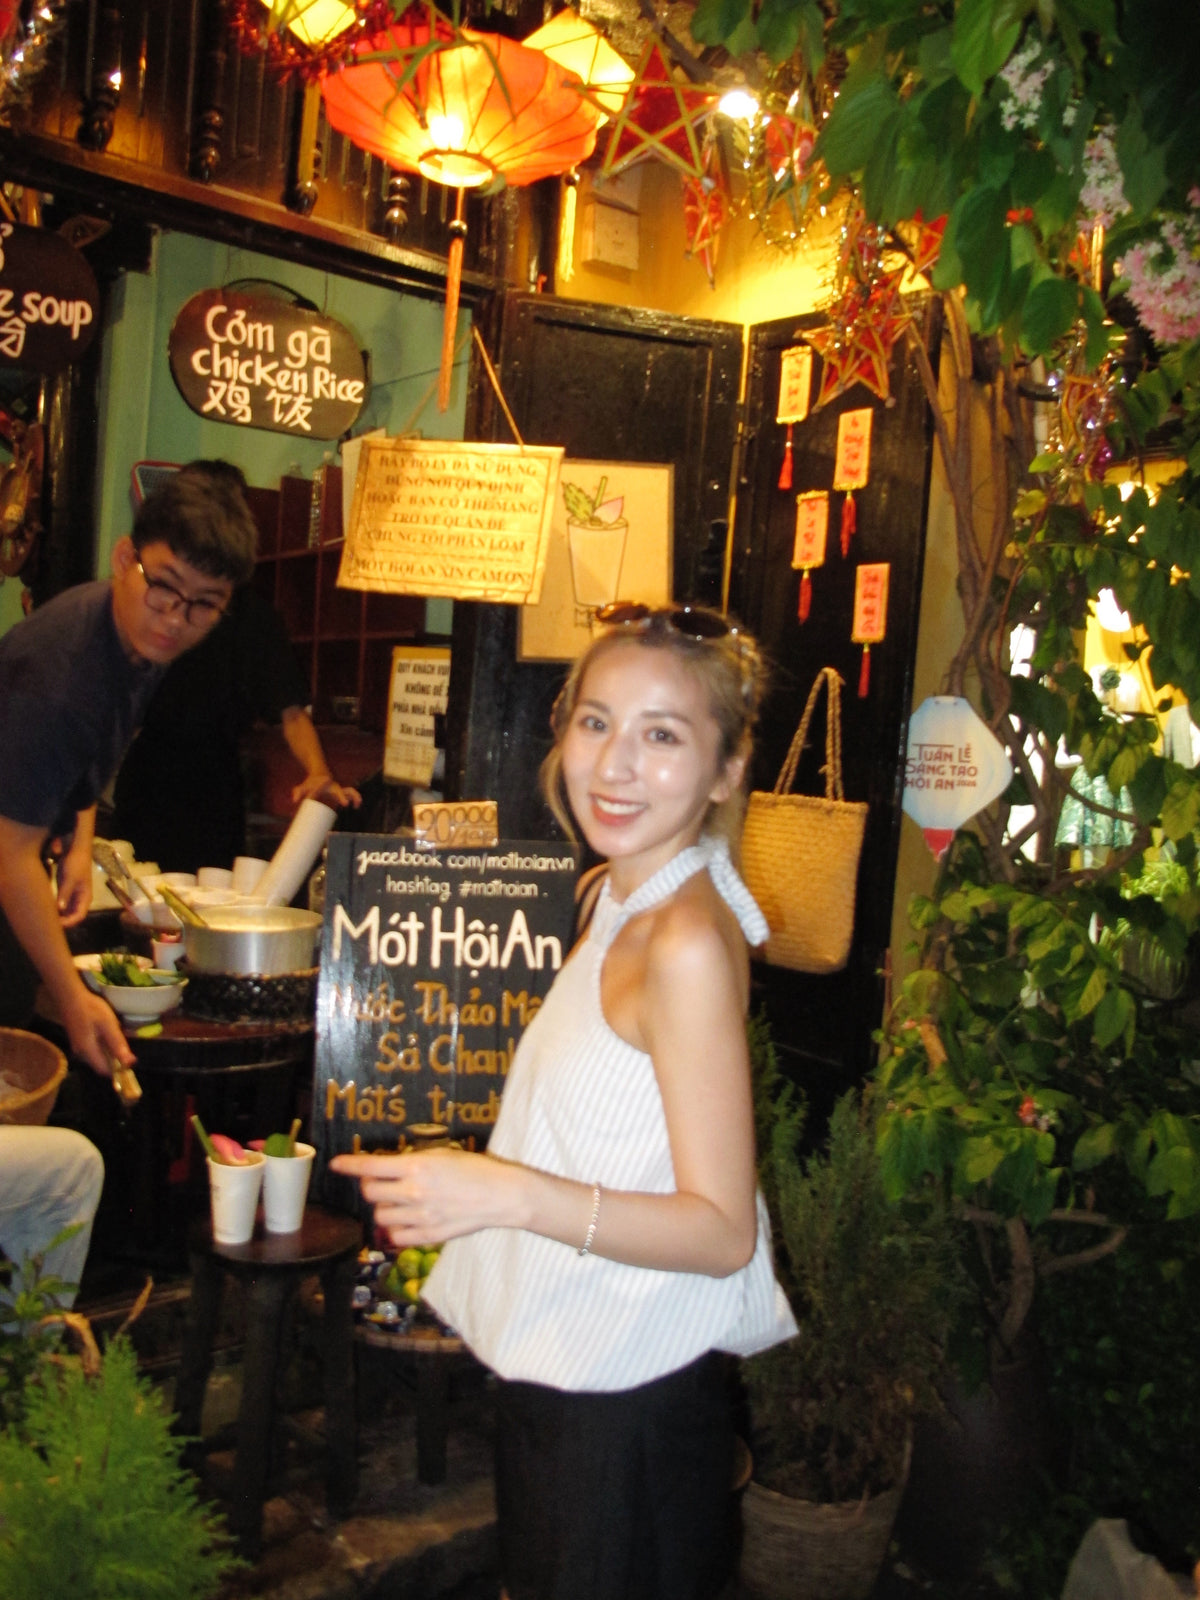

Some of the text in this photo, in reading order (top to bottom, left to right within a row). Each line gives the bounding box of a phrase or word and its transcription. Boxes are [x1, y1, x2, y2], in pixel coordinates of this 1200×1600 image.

[284, 325, 331, 369] gà
[313, 365, 364, 404] Rice
[386, 874, 538, 902] hashtag #mothoian
[331, 903, 563, 978] Mót Hội An
[413, 980, 497, 1026] Thảo
[376, 1032, 421, 1074] Sả
[427, 1084, 502, 1124] trad
